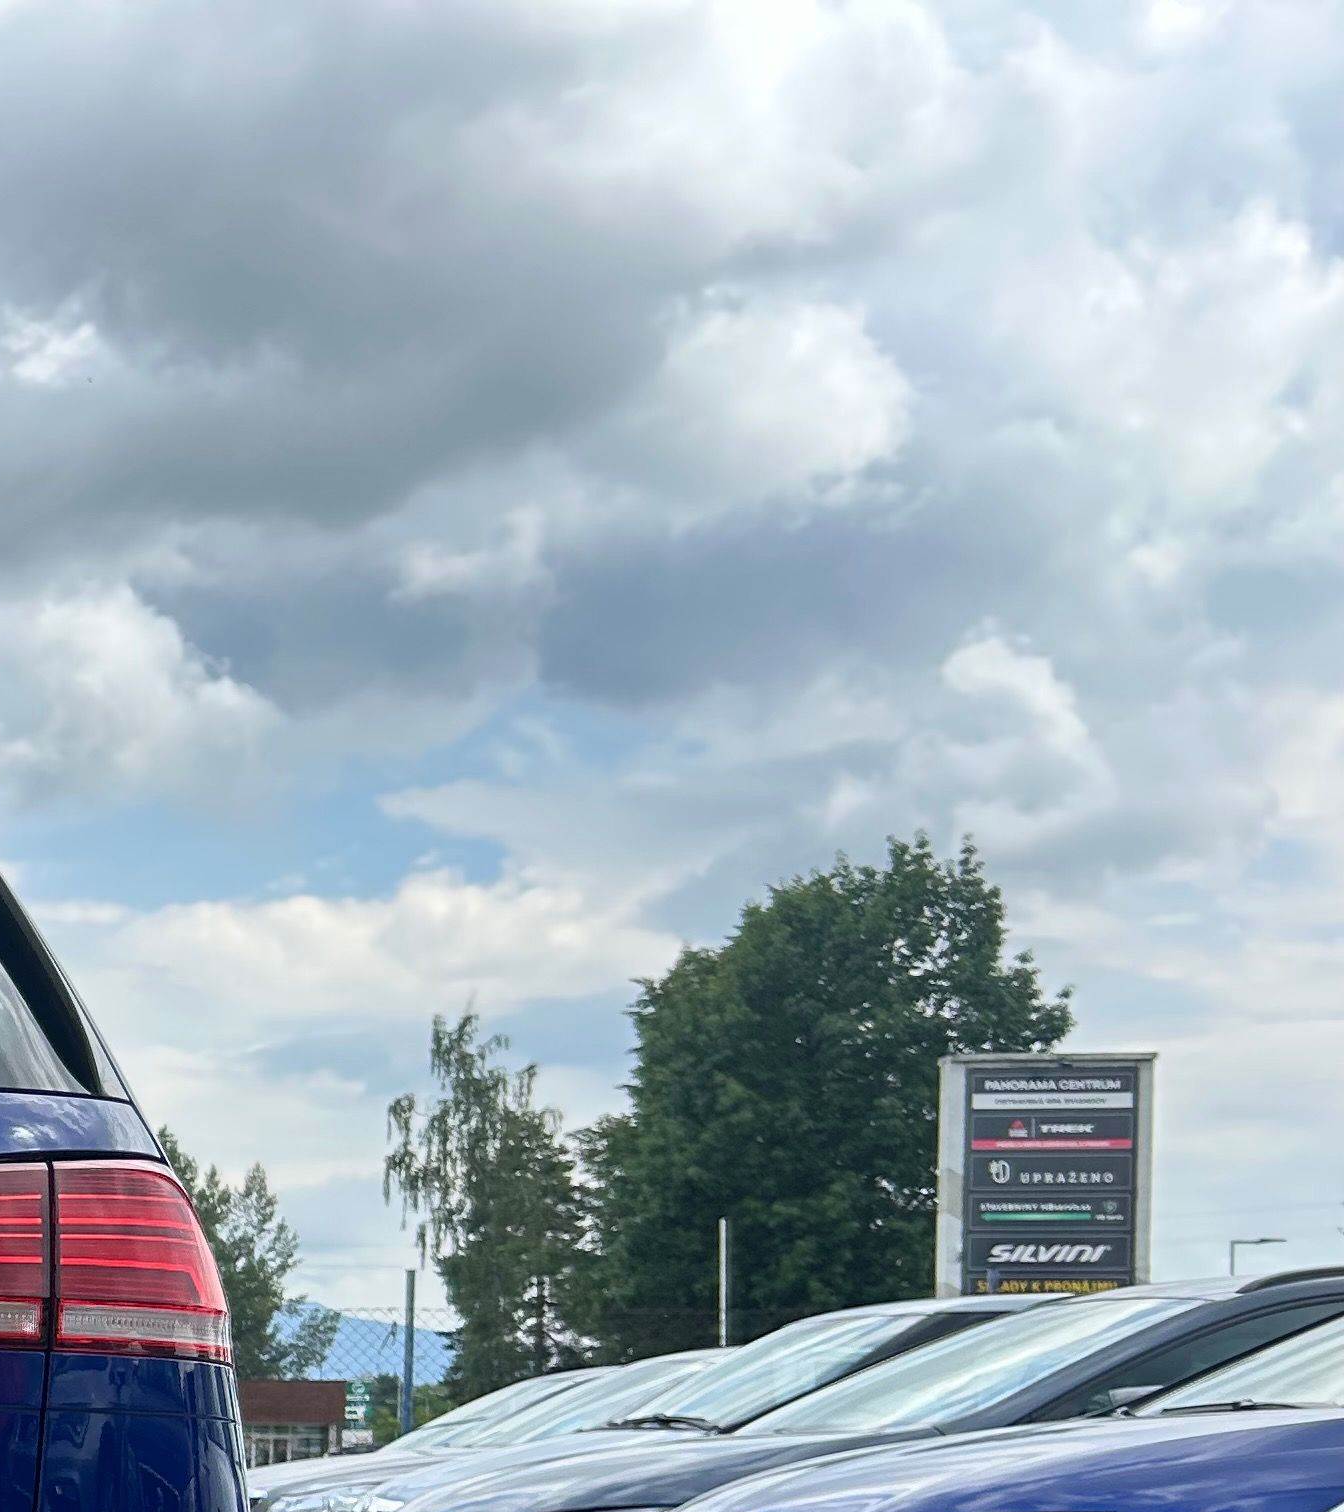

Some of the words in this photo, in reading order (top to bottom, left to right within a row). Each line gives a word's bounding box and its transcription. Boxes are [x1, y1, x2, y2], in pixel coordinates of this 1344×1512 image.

[984, 1079, 1057, 1091] PANORAMA
[1059, 1079, 1122, 1090] CENTRUM
[987, 1243, 1108, 1263] SILVINI
